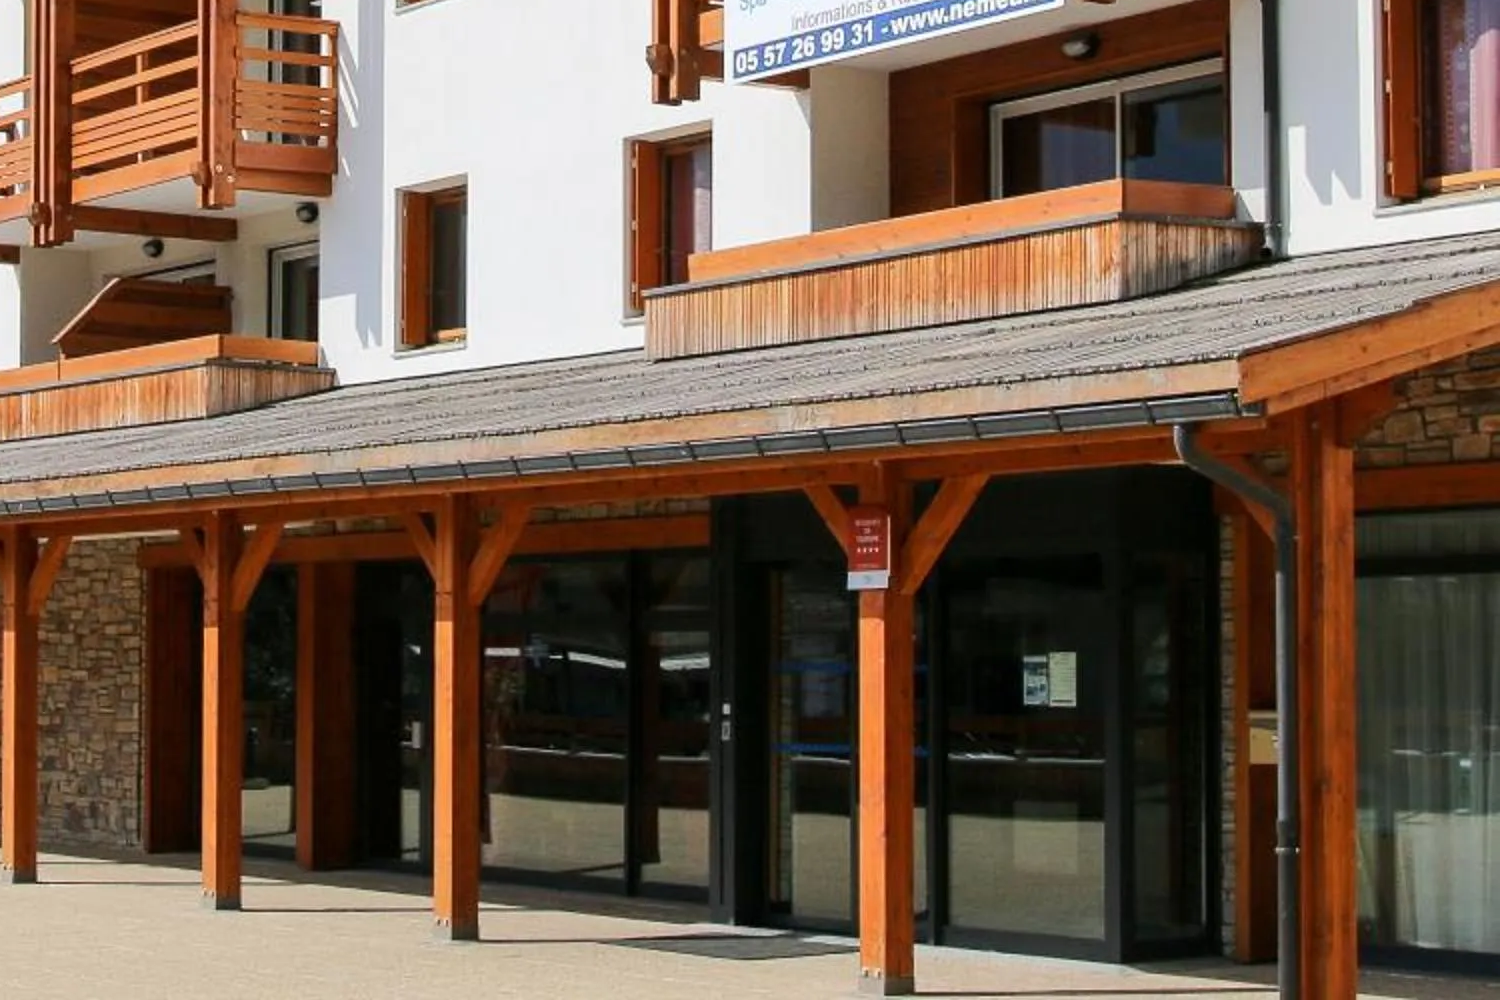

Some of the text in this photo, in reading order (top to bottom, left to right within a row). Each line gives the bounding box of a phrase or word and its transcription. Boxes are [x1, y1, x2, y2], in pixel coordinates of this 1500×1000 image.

[735, 50, 758, 73] 05
[763, 43, 786, 67] 57
[791, 35, 815, 61] 26
[820, 27, 844, 53] 99
[851, 20, 873, 45] 31
